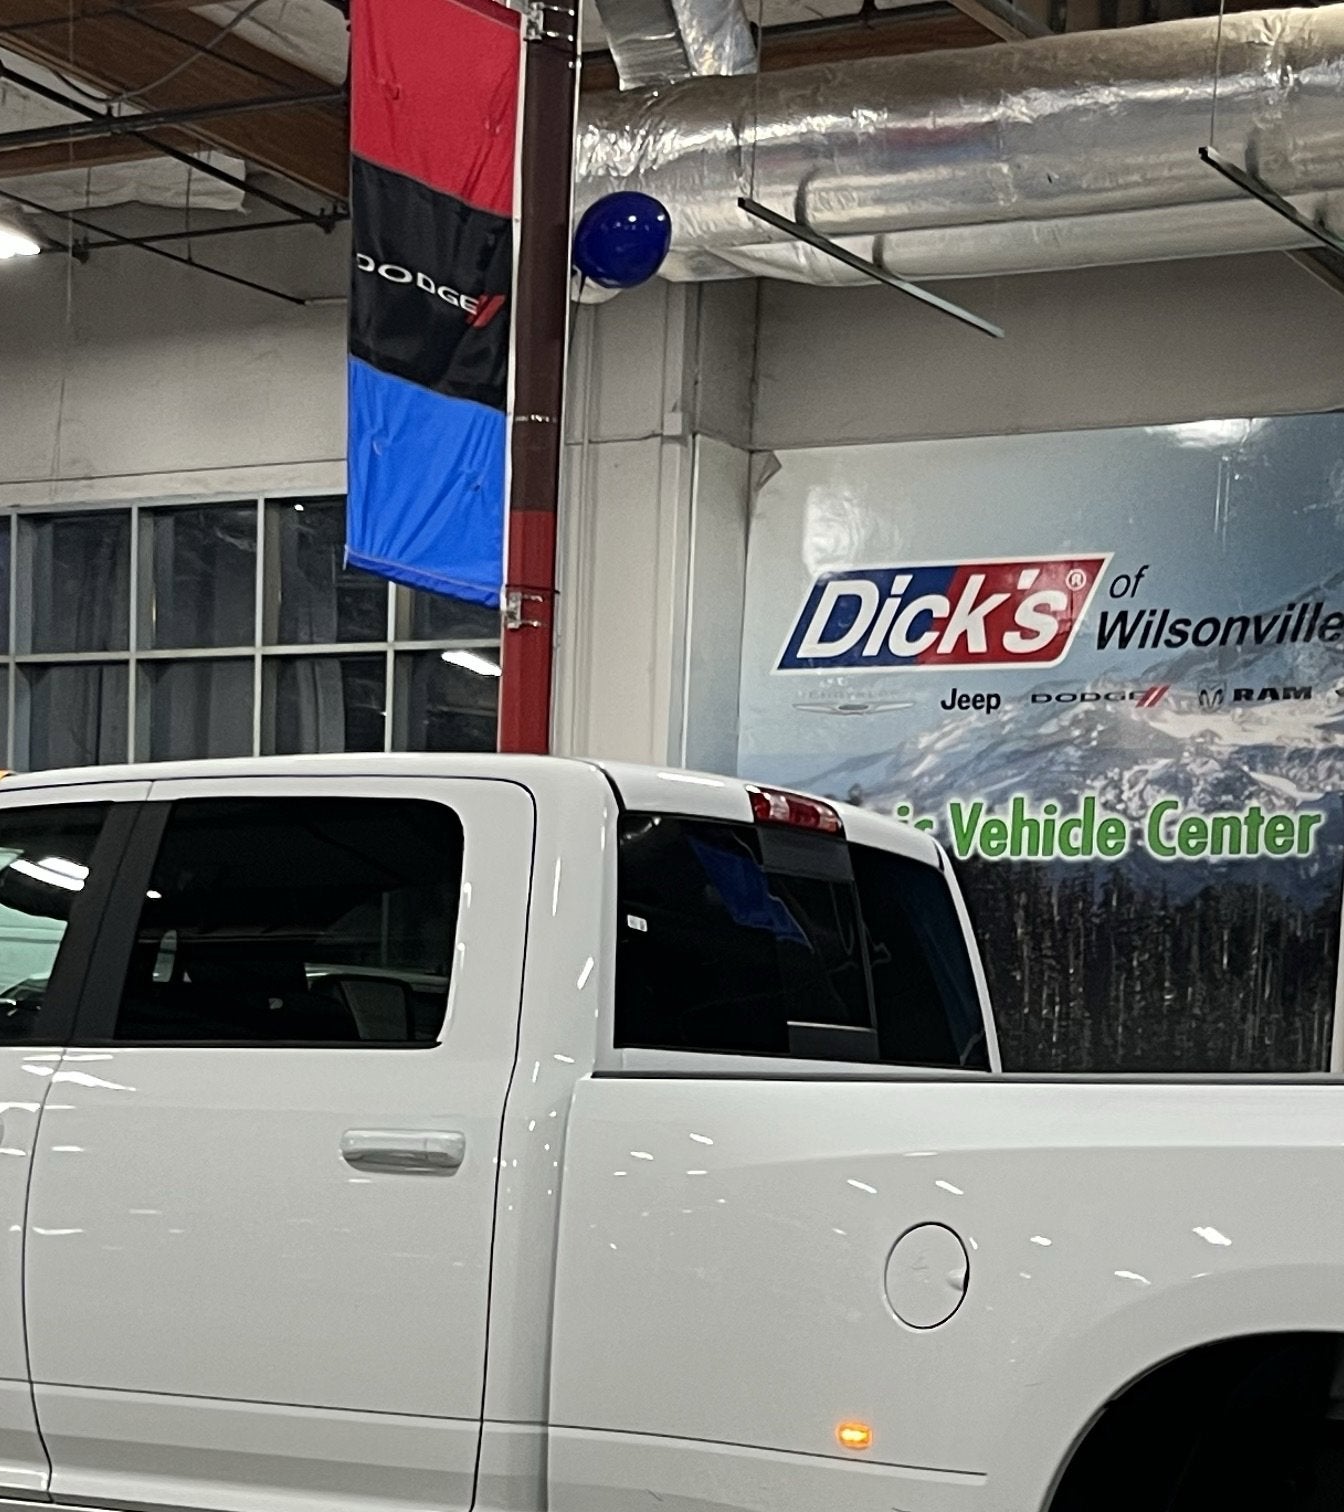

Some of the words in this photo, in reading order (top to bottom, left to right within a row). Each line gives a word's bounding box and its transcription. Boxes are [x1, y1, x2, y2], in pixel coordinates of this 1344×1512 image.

[357, 253, 480, 315] DODGE
[1109, 565, 1149, 598] of
[795, 568, 1068, 658] Dick's
[940, 688, 1001, 714] Jeep
[1233, 686, 1312, 701] RAM
[949, 796, 1127, 857] Vehicle
[1147, 800, 1322, 856] Center
